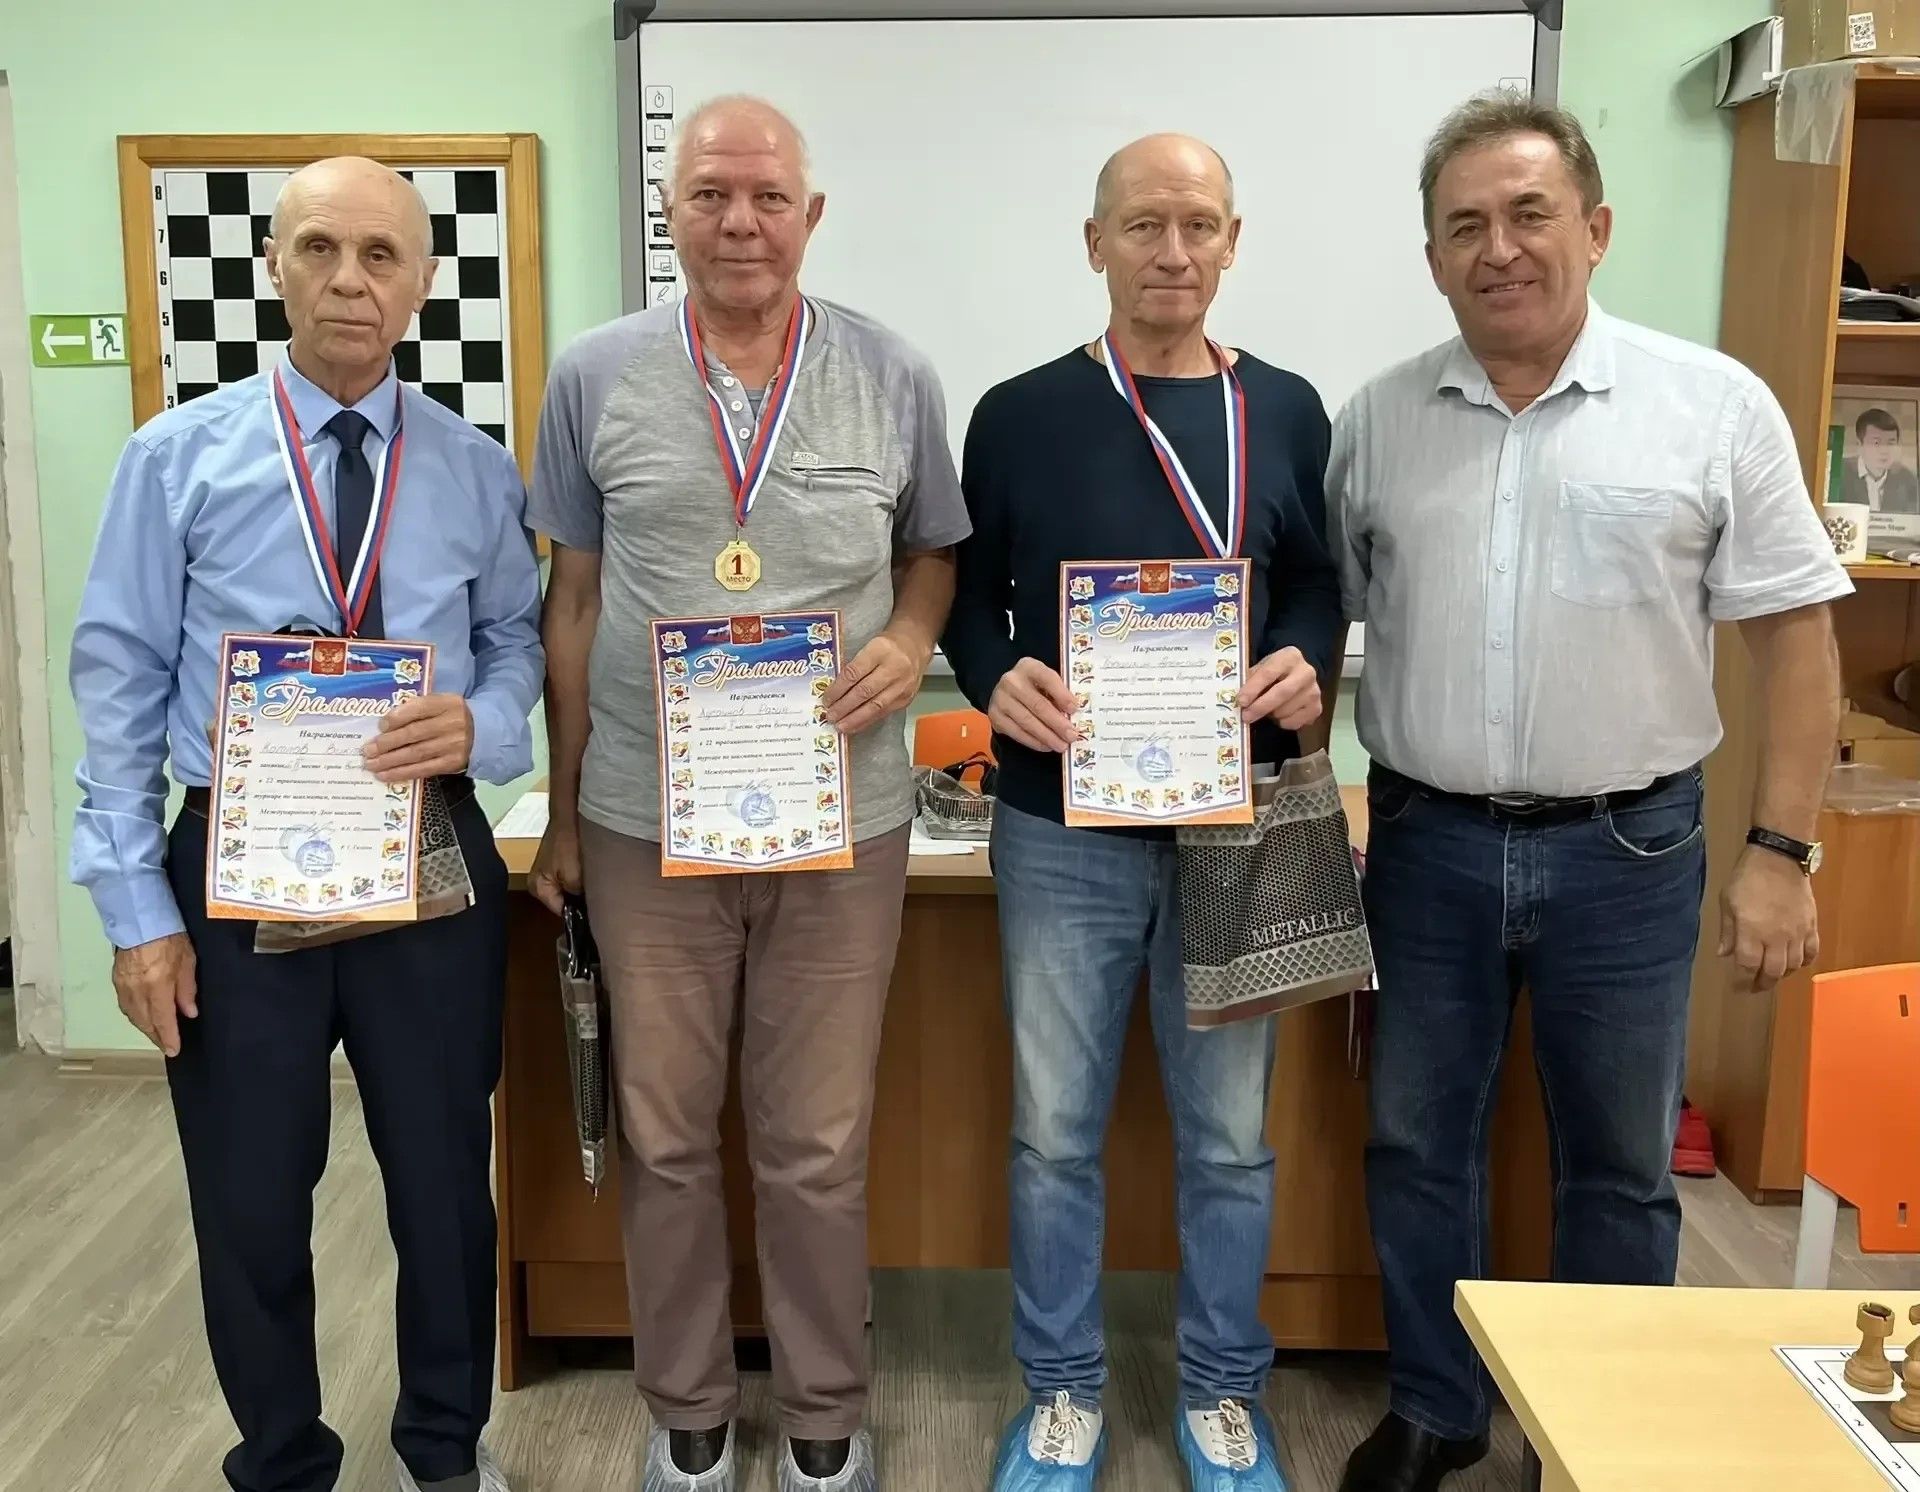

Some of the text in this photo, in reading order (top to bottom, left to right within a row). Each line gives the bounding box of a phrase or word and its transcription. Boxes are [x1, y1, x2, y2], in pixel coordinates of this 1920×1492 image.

[155, 186, 162, 200] 8
[158, 229, 165, 243] 7
[160, 271, 167, 285] 6
[162, 312, 169, 326] 5
[164, 354, 172, 368] 4
[167, 395, 174, 409] 3
[732, 554, 743, 575] 1
[1097, 598, 1213, 642] Грамота
[1132, 645, 1188, 654] Награждается
[692, 648, 808, 691] Грамота
[260, 677, 391, 725] Грамота
[729, 693, 785, 701] Награждается
[299, 730, 362, 740] Награждается
[1252, 907, 1355, 946] METALLIC
